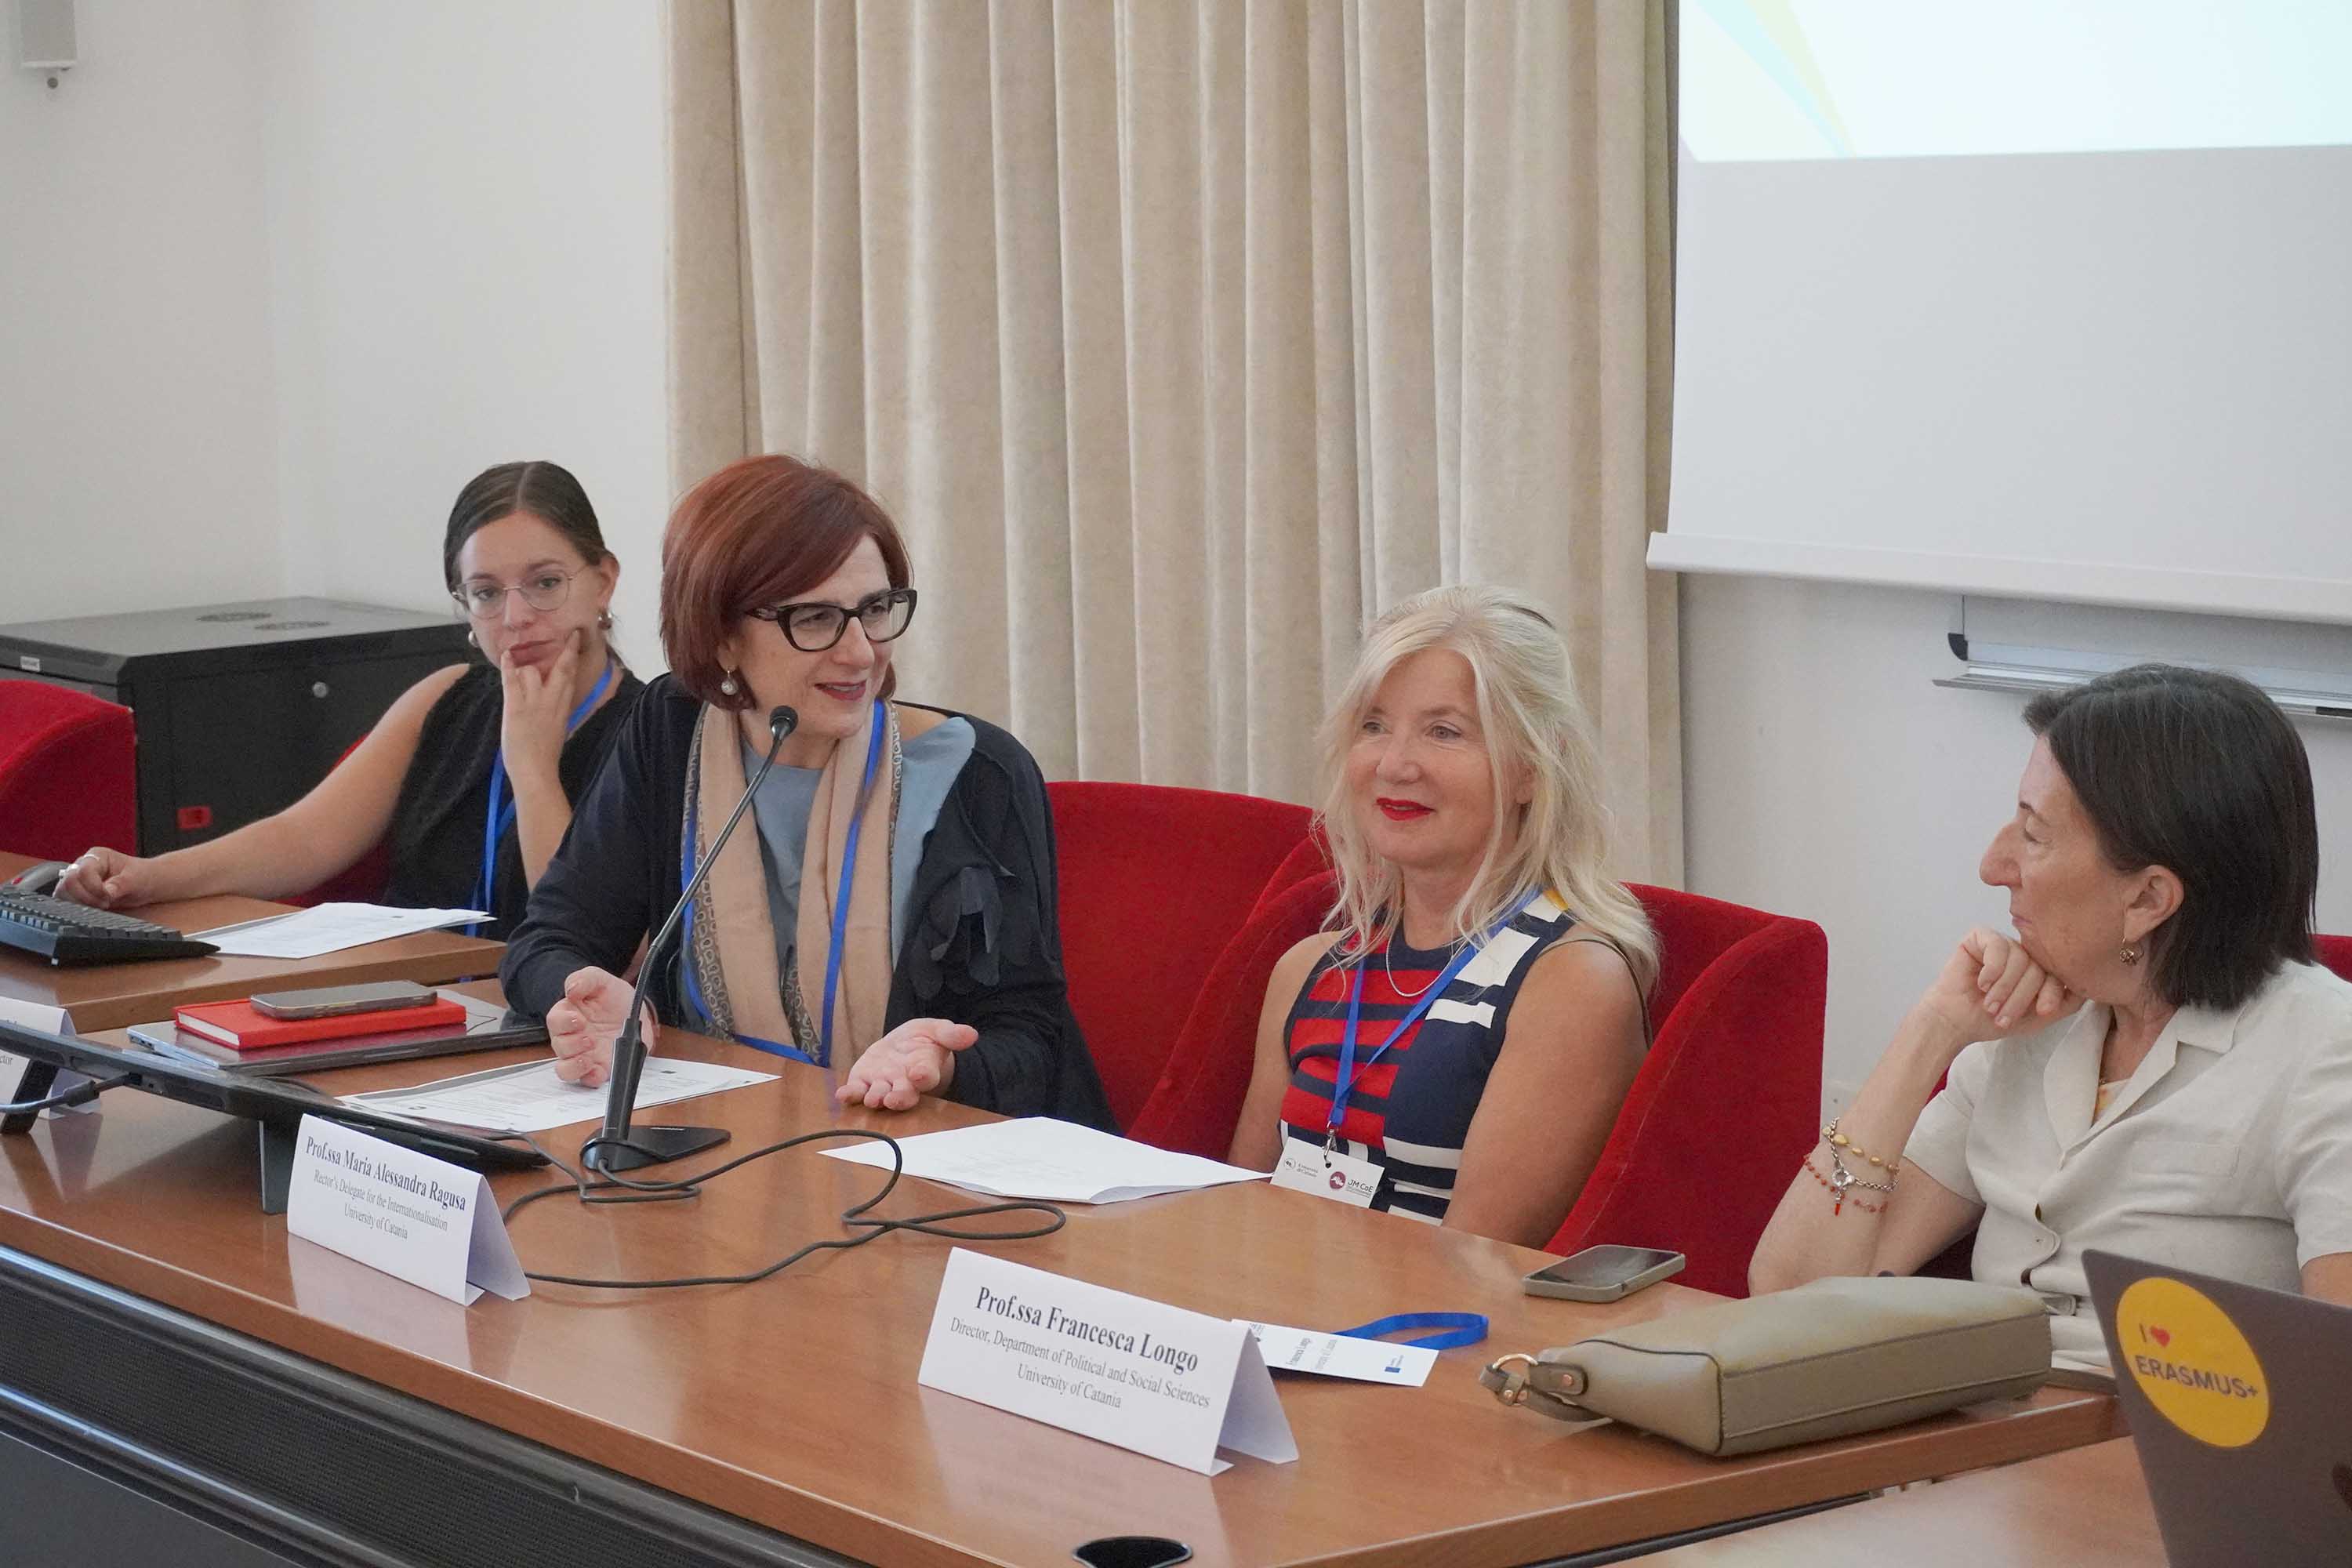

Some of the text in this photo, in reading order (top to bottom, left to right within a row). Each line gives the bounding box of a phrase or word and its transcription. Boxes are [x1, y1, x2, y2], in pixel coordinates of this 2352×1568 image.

[306, 1136, 466, 1211] Prof.ssa Maria Alessandra Ragusa
[1348, 1178, 1360, 1189] JM
[314, 1169, 448, 1232] Rector's Delegate for the Internationalisation
[344, 1203, 408, 1240] University of Catania
[975, 1286, 1198, 1375] Prof.ssa Francesca Longo
[2138, 1323, 2147, 1343] I
[993, 1330, 1050, 1361] Department
[1051, 1348, 1065, 1364] of
[1065, 1351, 1107, 1377] Political
[1107, 1368, 1128, 1384] and
[1128, 1370, 1163, 1393] Social
[1163, 1381, 1211, 1408] Sciences
[1018, 1363, 1122, 1409] University of Catania
[2134, 1355, 2259, 1399] ERASMUS+
